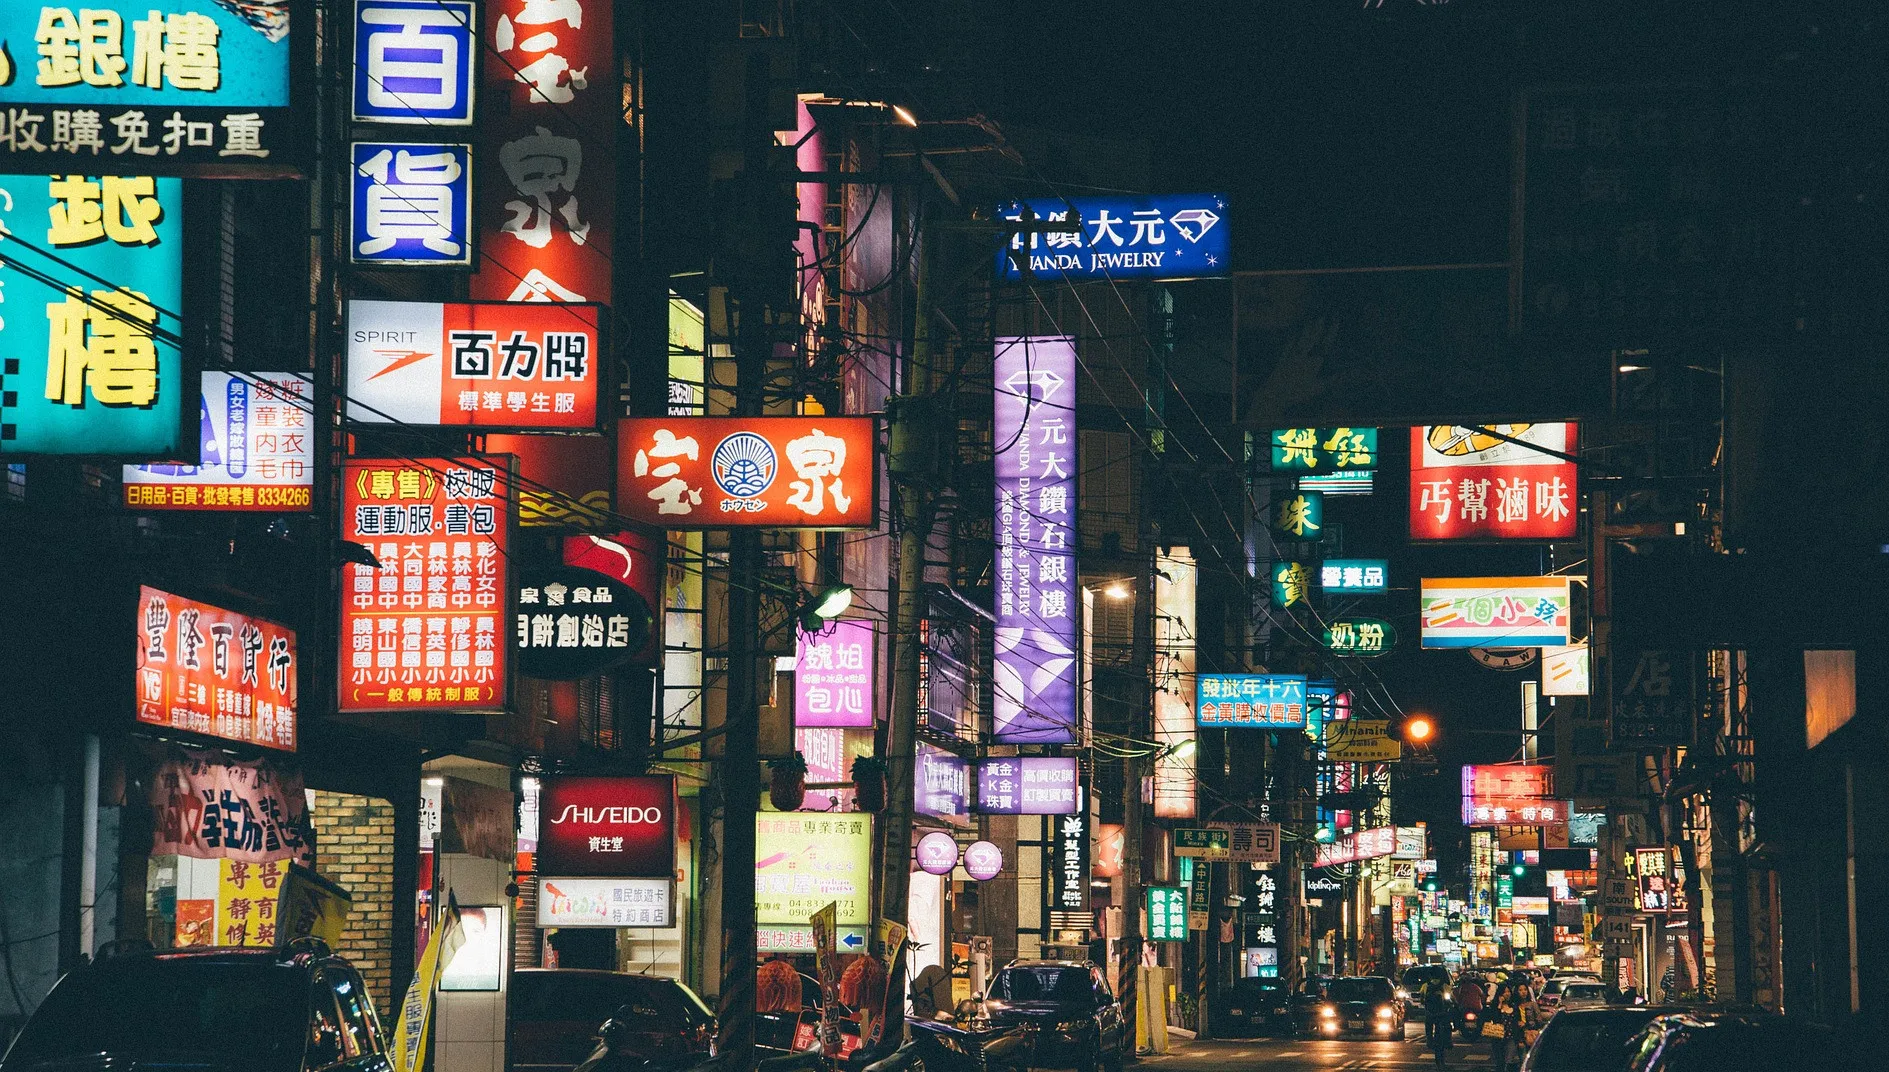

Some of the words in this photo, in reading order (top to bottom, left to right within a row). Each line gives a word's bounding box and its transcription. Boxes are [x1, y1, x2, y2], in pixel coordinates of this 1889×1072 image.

[358, 7, 465, 257] 百貨
[1090, 252, 1165, 272] JEWELRY
[354, 331, 418, 343] SPIRIT
[448, 331, 588, 382] 百力牌
[458, 391, 576, 414] 標準學生服
[256, 406, 304, 427] 童裝
[256, 432, 304, 453] 內衣
[256, 458, 304, 479] 毛巾
[444, 469, 496, 500] 校服
[257, 488, 310, 506] 8334266
[721, 499, 767, 512] ホウセン
[1420, 476, 1570, 524] 丐幫滷味
[1019, 477, 1031, 543] DIAMOND
[1039, 417, 1066, 619] 元大鑽石銀樓
[402, 542, 423, 609] 大同國中
[427, 542, 448, 609] 員林家商
[451, 542, 472, 609] 員林高中
[475, 541, 497, 608] 彰化女中
[1322, 566, 1383, 588] 營養品
[572, 587, 613, 603] 食品
[1018, 563, 1031, 617] JEWELRY
[1331, 622, 1384, 651] 奶粉
[376, 618, 398, 685] 東山國小
[805, 643, 865, 670] 魏姐
[805, 686, 865, 714] 包心
[986, 762, 1013, 776] 黃金
[1023, 769, 1074, 783] 高價收購
[986, 795, 1013, 809] 珠寶
[551, 804, 662, 824] SHISEIDO
[588, 836, 624, 852] 資生堂
[1232, 827, 1275, 853] 壽司
[613, 888, 664, 902] 國民旅遊卡
[1195, 869, 1206, 903] 中正路
[613, 908, 664, 923] 特約商店
[1609, 922, 1629, 933] 141
